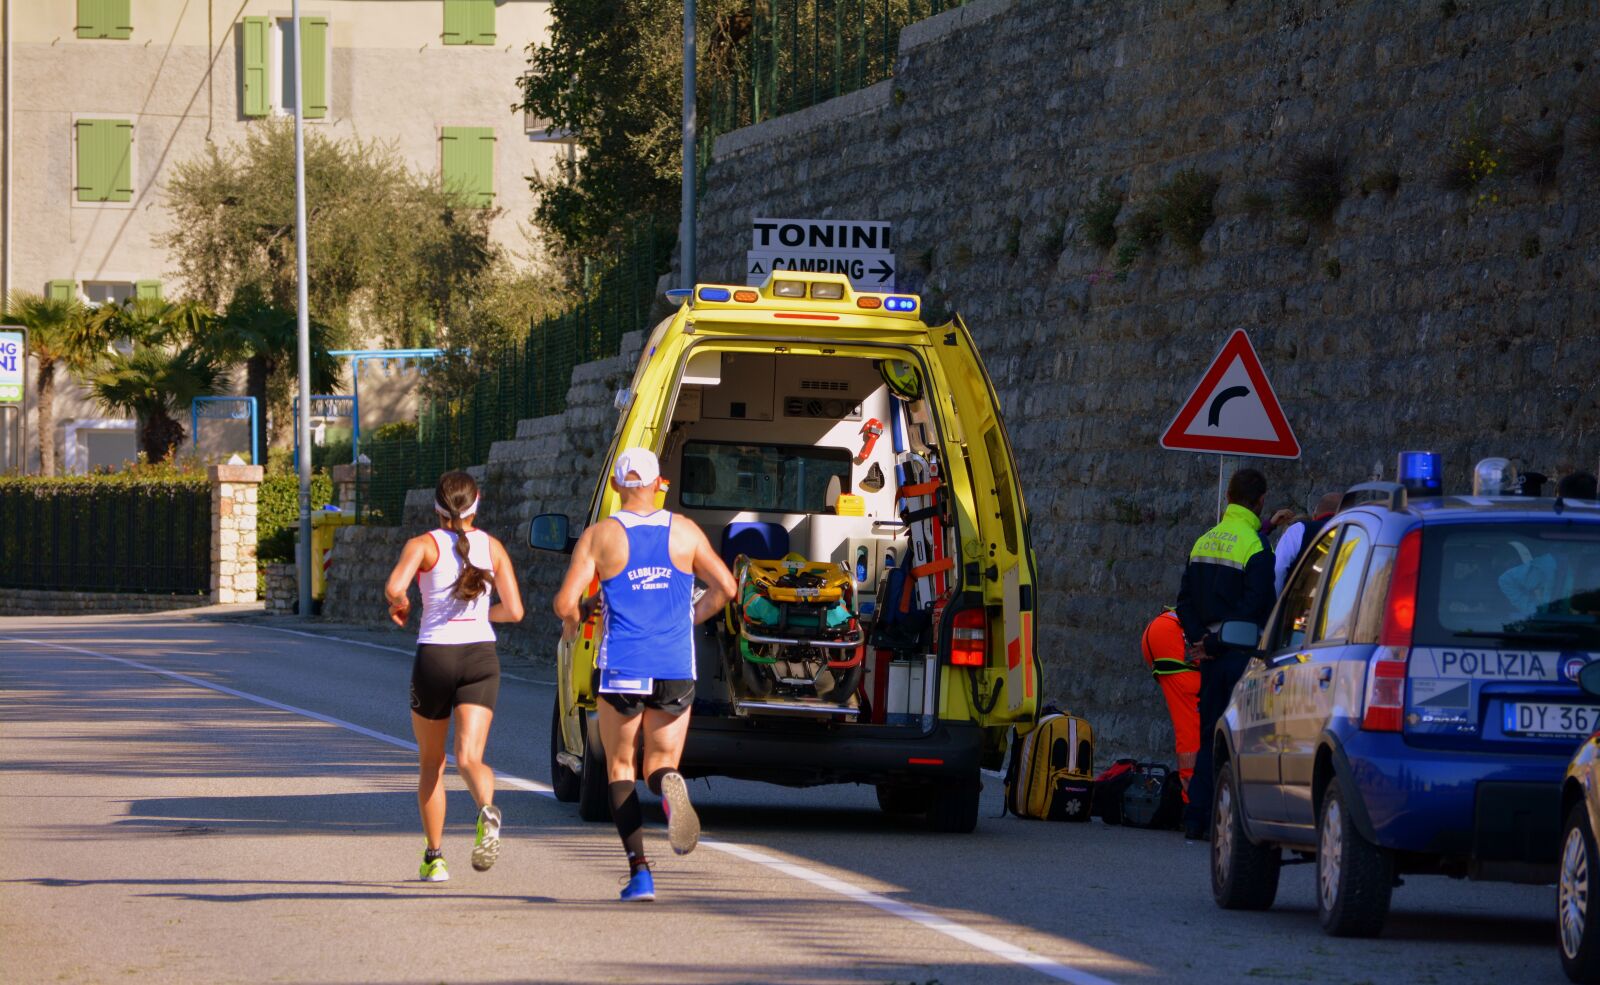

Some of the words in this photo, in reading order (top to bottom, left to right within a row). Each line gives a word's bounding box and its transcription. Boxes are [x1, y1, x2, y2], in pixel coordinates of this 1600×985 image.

[753, 223, 890, 249] TONINI
[772, 257, 864, 280] CAMPING
[631, 583, 641, 591] SV
[1442, 651, 1546, 677] POLIZIA
[1520, 705, 1548, 730] DY
